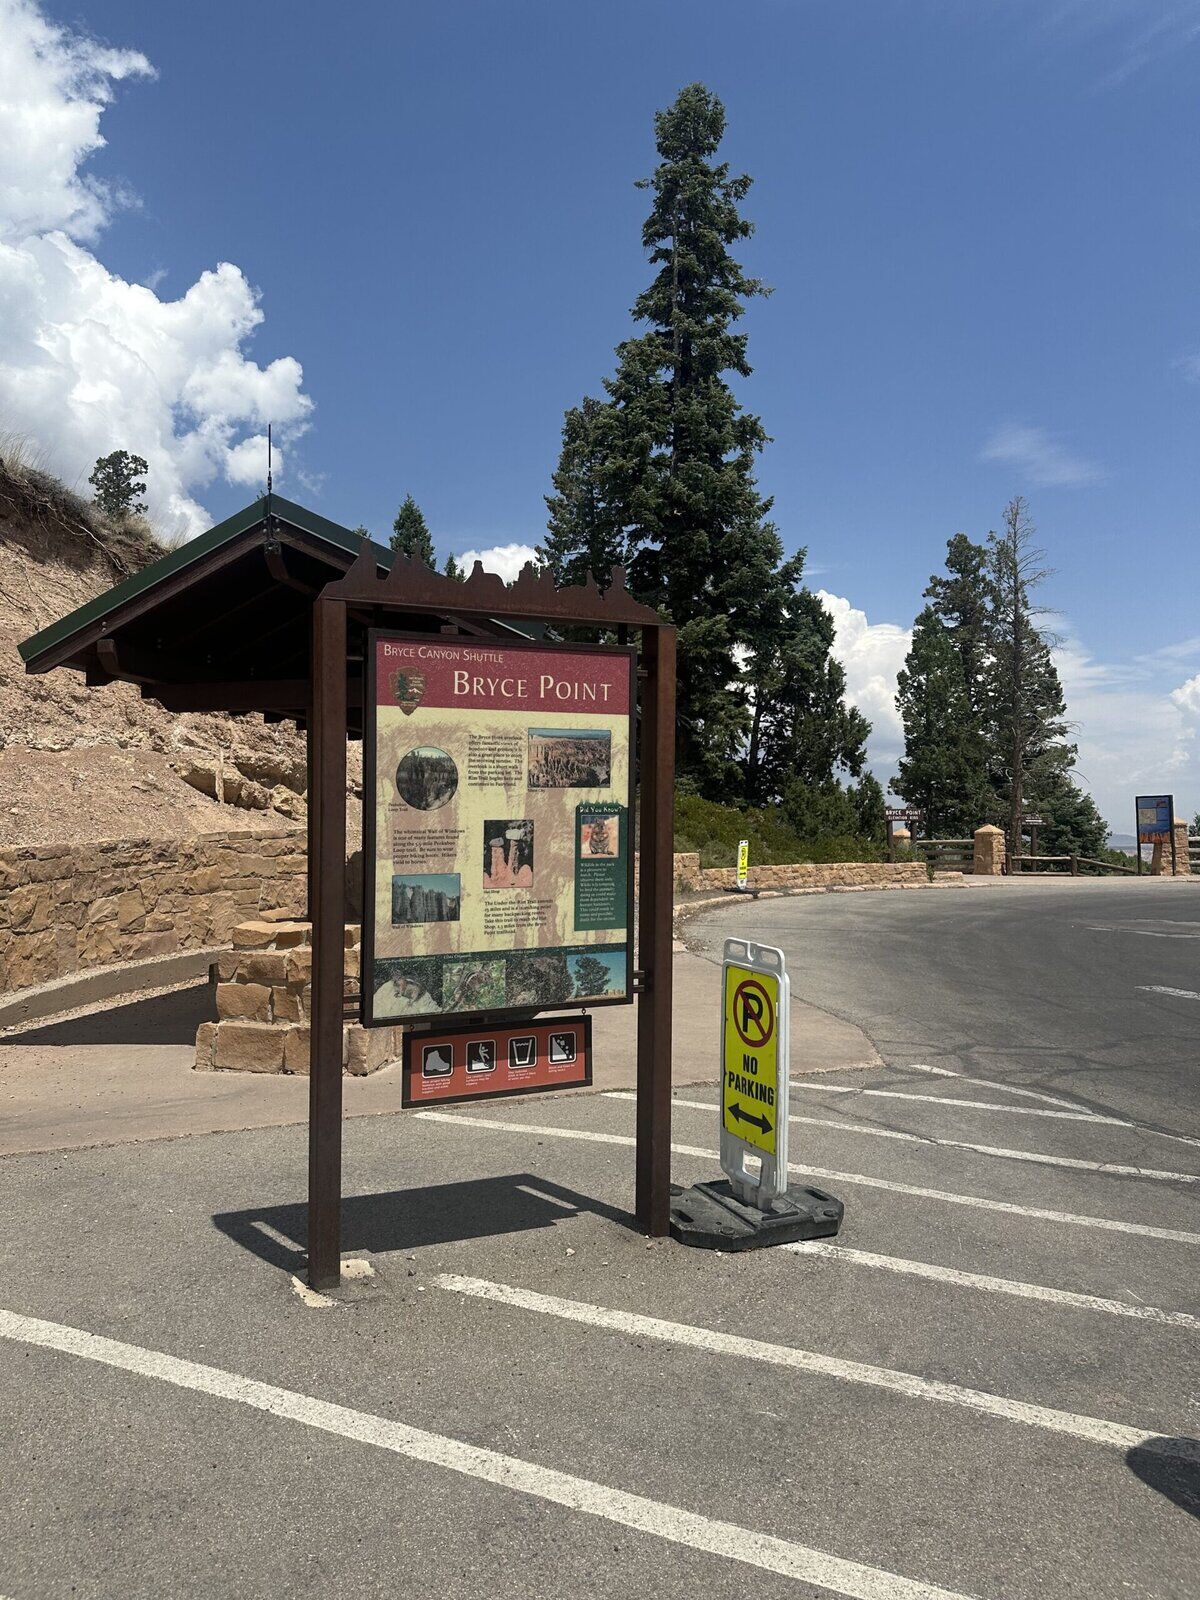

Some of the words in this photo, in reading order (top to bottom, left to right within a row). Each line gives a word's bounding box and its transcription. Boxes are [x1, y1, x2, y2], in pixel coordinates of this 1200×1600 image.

[384, 645, 415, 658] BRYCE
[418, 647, 460, 660] CANYON
[463, 650, 504, 663] SHUTTLE
[454, 670, 528, 698] BRYCE
[540, 675, 612, 701] POINT
[743, 1054, 758, 1075] NO
[728, 1071, 774, 1106] PARKING
